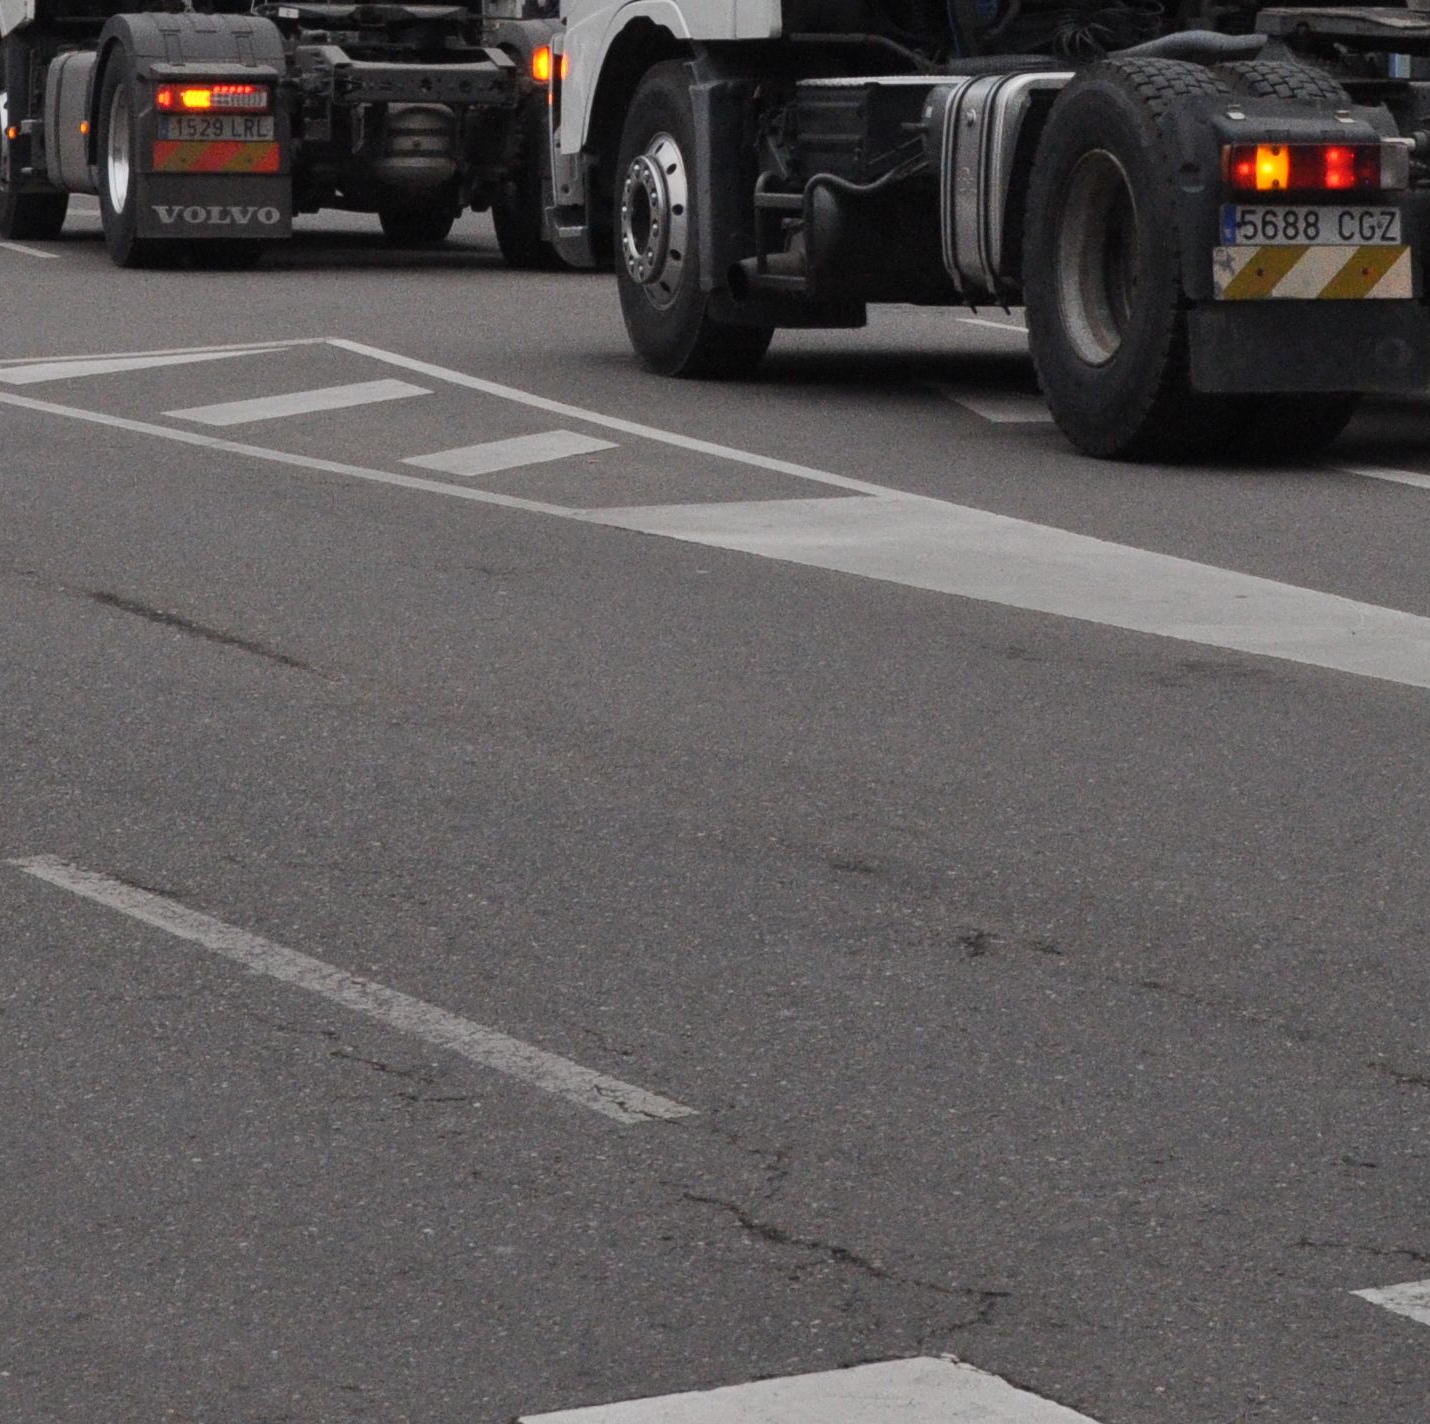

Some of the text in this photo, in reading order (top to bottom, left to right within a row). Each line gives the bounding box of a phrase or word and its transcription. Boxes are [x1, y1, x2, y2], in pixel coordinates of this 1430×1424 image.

[176, 119, 268, 137] 1529 LRL
[152, 205, 281, 225] VOLVO
[1240, 210, 1397, 241] 5688 CGZ
